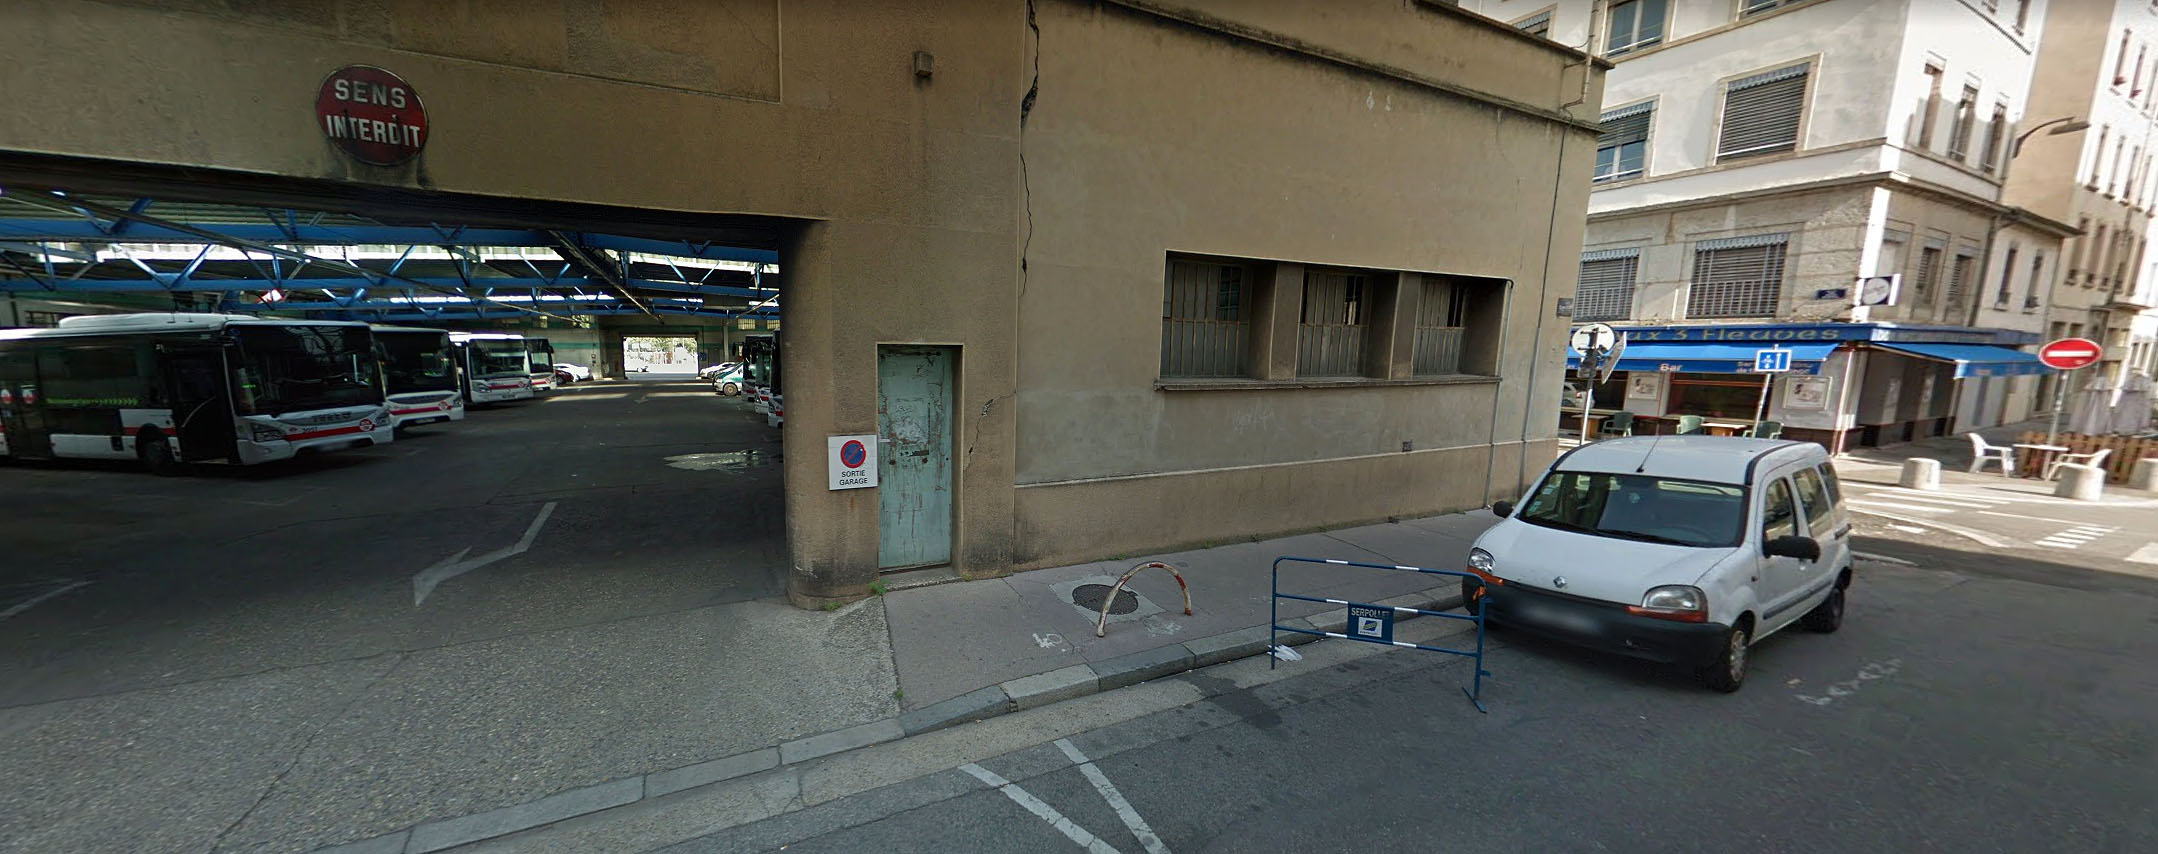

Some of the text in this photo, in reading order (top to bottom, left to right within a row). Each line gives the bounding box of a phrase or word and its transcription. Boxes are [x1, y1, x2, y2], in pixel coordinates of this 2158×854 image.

[335, 79, 406, 109] SENS
[326, 115, 420, 148] INTERDIT
[1671, 330, 1688, 341] 3
[1660, 362, 1683, 372] Bar
[839, 478, 868, 486] GARAGE
